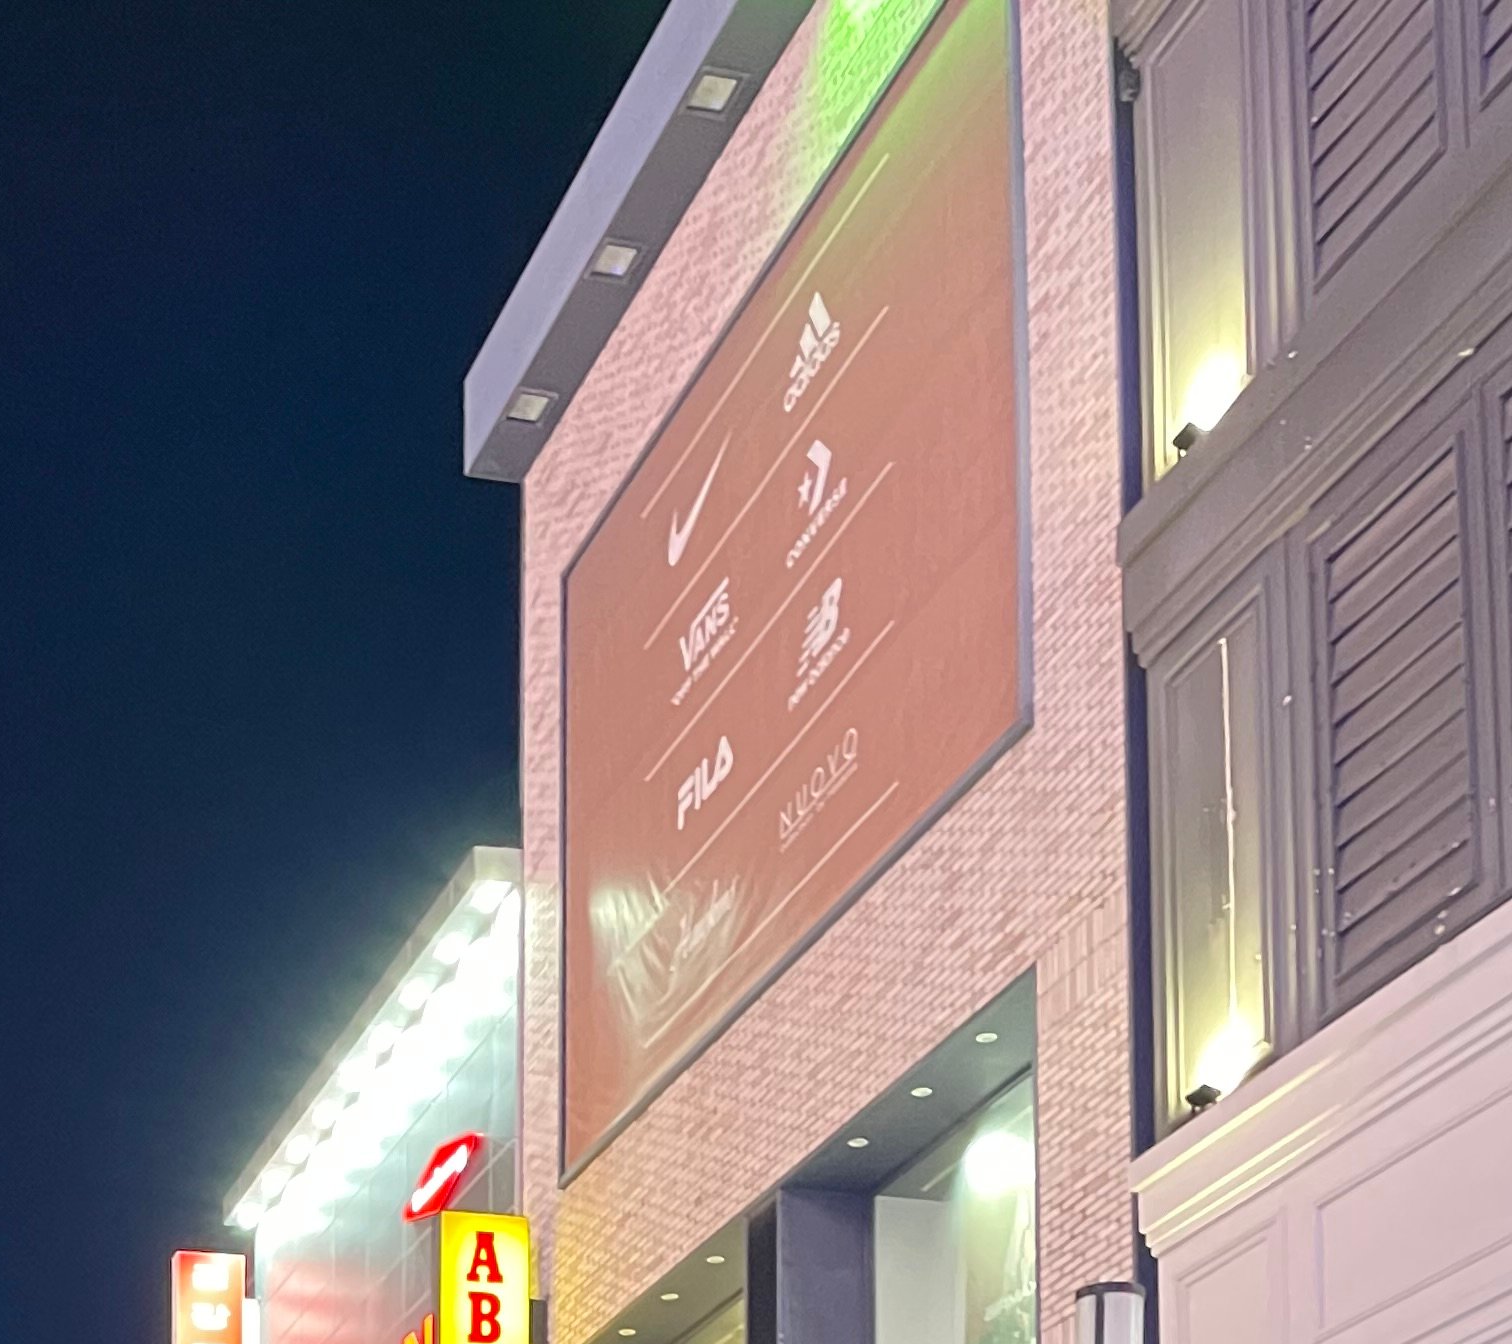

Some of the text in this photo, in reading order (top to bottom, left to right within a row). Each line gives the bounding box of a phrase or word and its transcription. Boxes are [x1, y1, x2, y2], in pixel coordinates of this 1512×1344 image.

[679, 576, 730, 671] VANS
[677, 735, 734, 831] FILA
[779, 728, 859, 841] NUOVO
